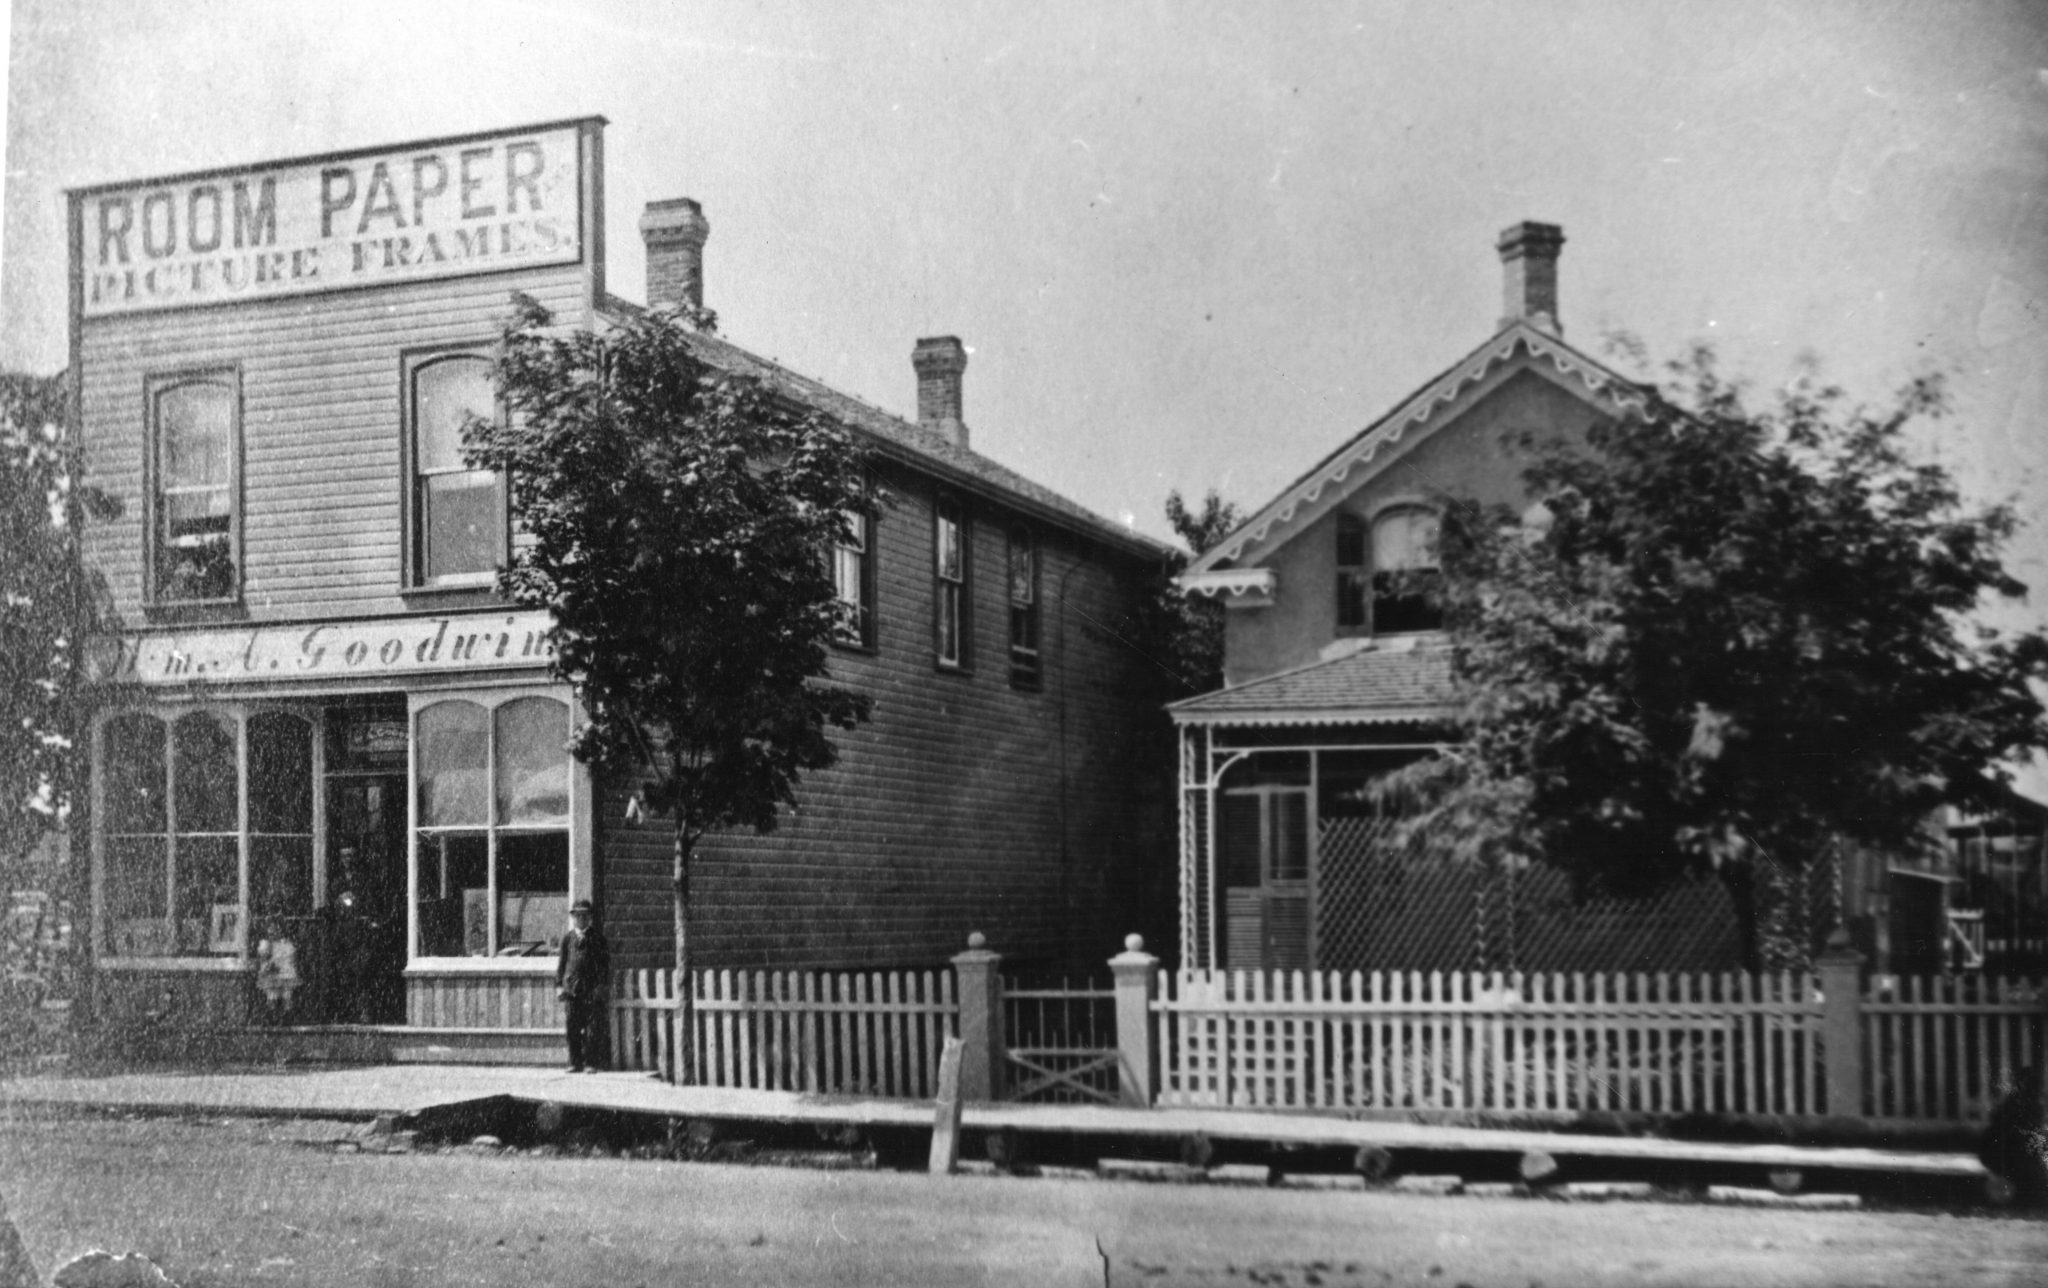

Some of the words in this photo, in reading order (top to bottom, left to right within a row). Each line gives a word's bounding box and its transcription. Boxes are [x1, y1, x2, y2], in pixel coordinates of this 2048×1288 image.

[99, 177, 277, 266] ROOM
[320, 141, 545, 238] PAPER
[90, 247, 318, 302] PICTURE
